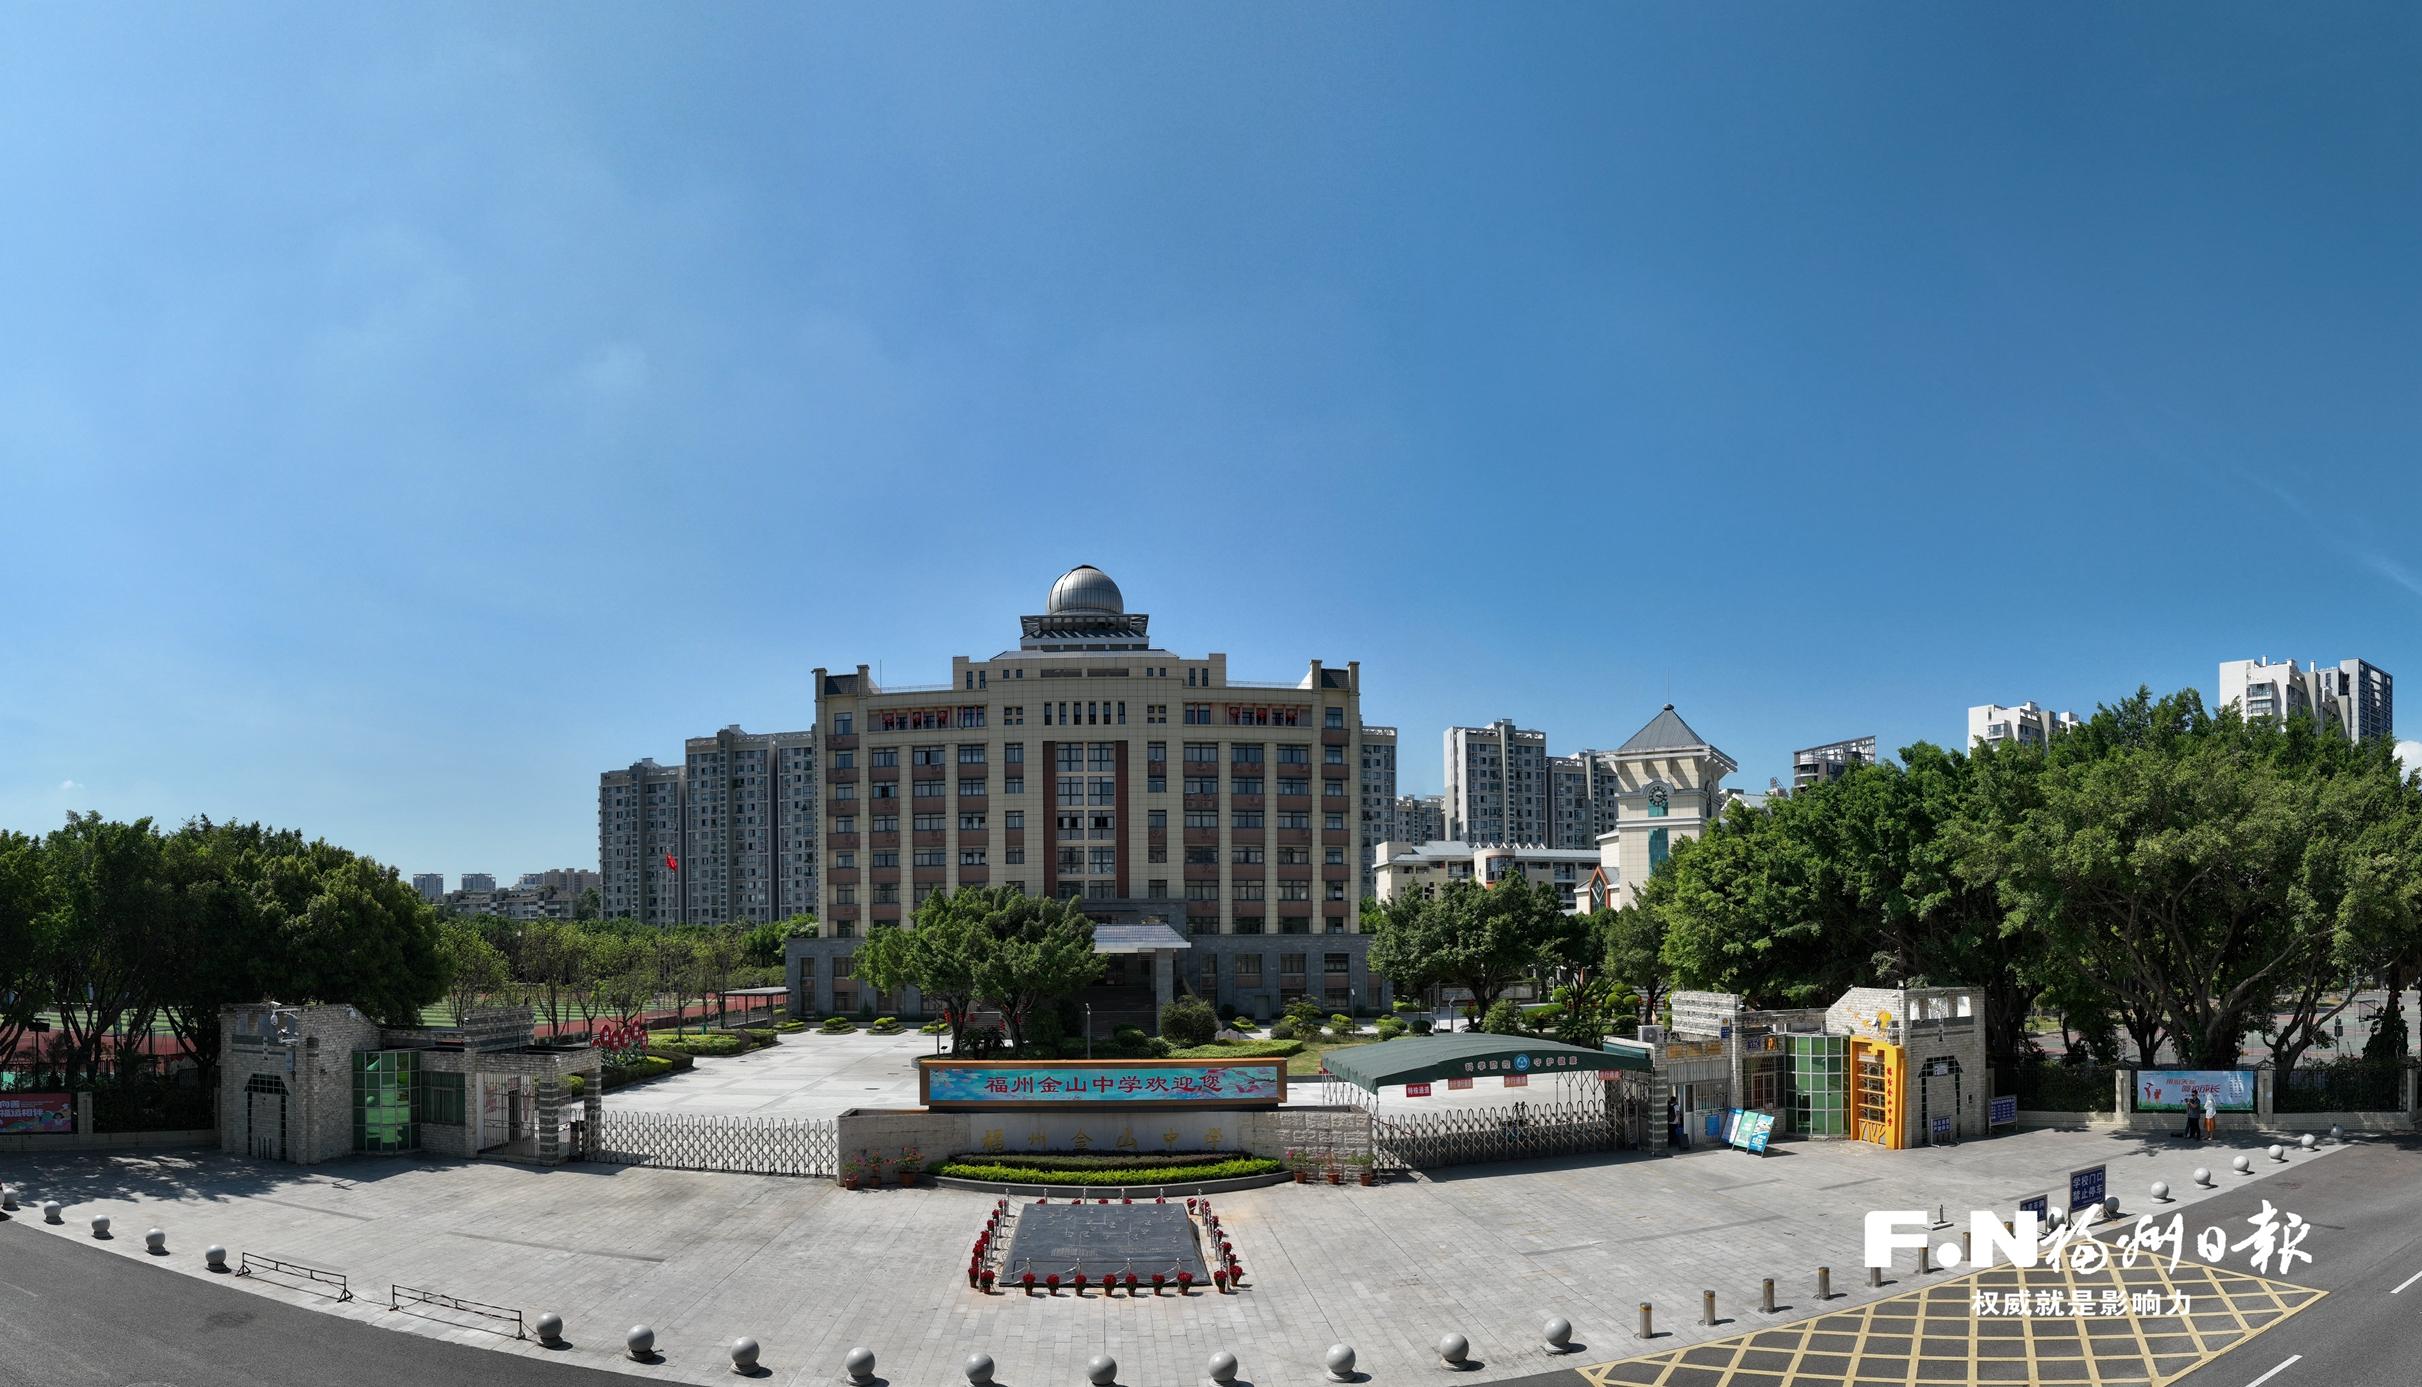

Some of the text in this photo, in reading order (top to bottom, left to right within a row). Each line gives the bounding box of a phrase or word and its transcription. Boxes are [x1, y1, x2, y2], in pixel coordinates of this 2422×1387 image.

[984, 1075, 1223, 1094] 福州金山中学欢迎您
[982, 1127, 1225, 1150] 福州金山中学
[2072, 1172, 2103, 1189] 学校门口
[2072, 1184, 2104, 1202] 禁止停车
